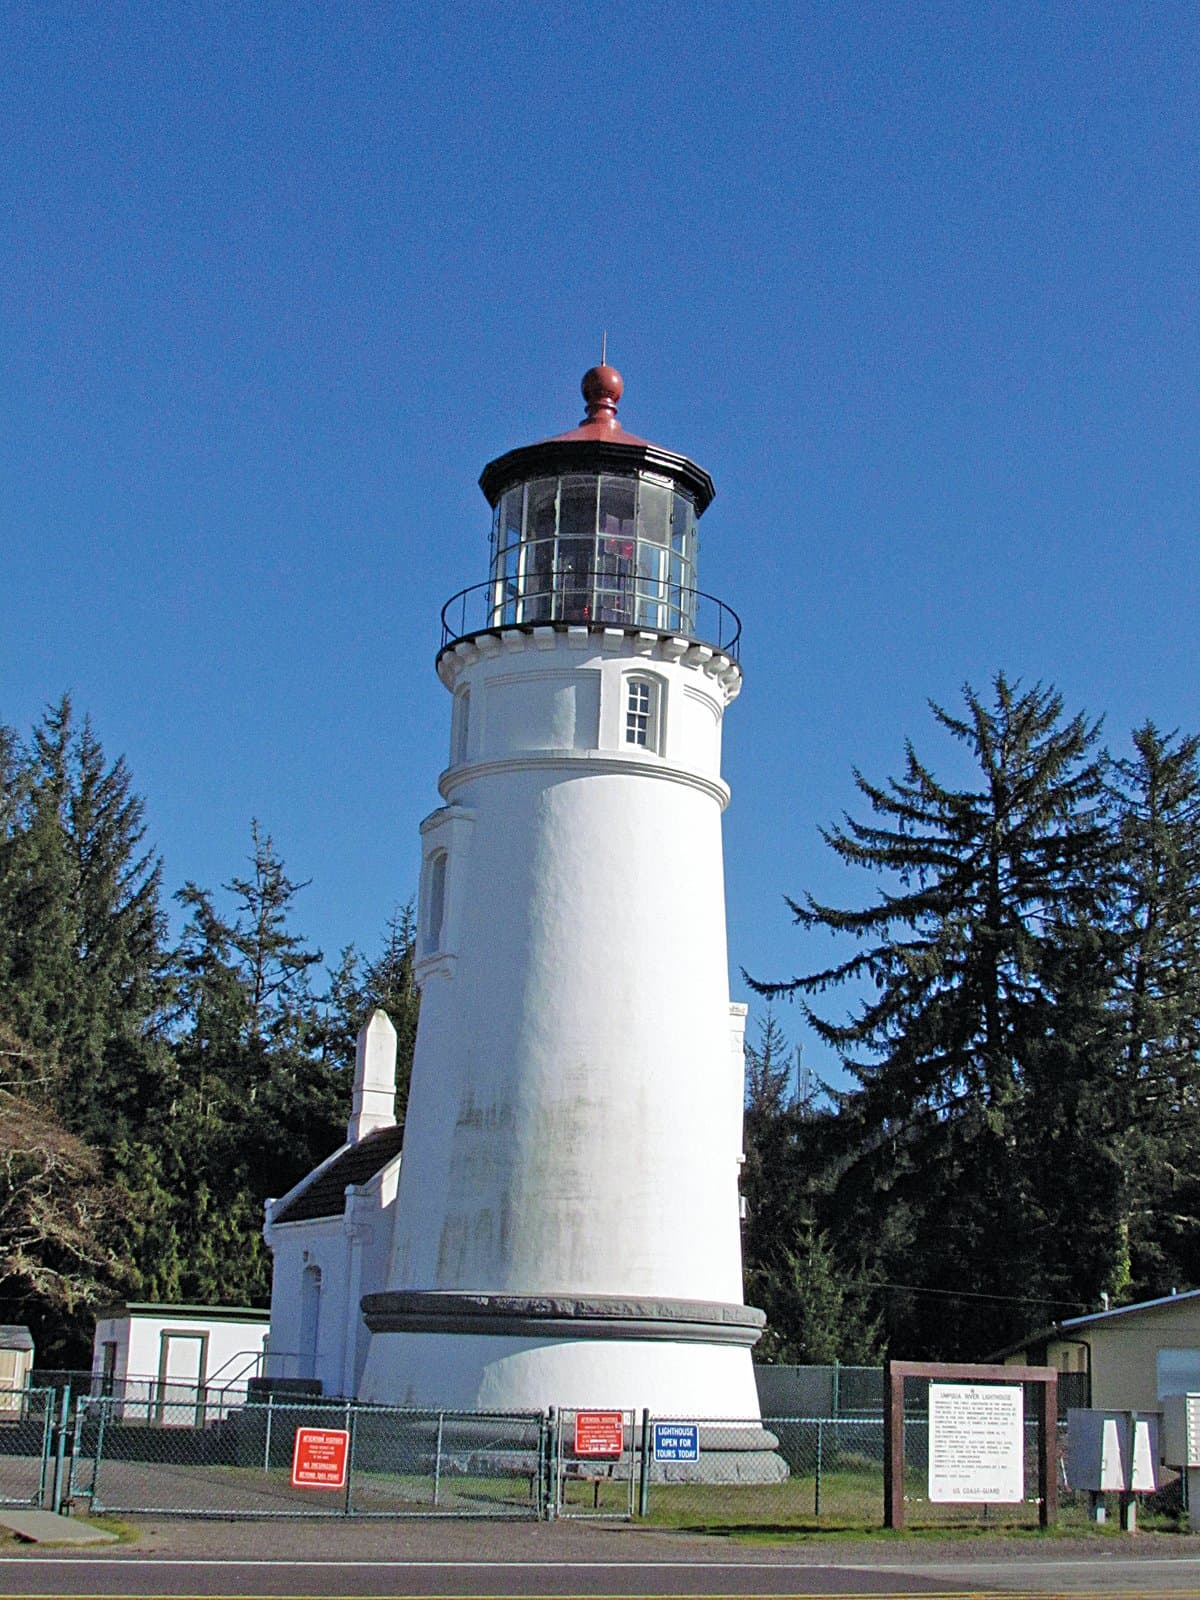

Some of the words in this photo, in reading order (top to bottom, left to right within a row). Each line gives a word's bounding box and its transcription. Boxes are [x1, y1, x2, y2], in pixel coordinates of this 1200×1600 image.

[658, 1427, 694, 1436] LIGHTHOUSE
[661, 1438, 677, 1447] OPEN
[679, 1438, 691, 1447] FOR
[657, 1449, 675, 1458] TOURS
[678, 1450, 696, 1458] TODAY
